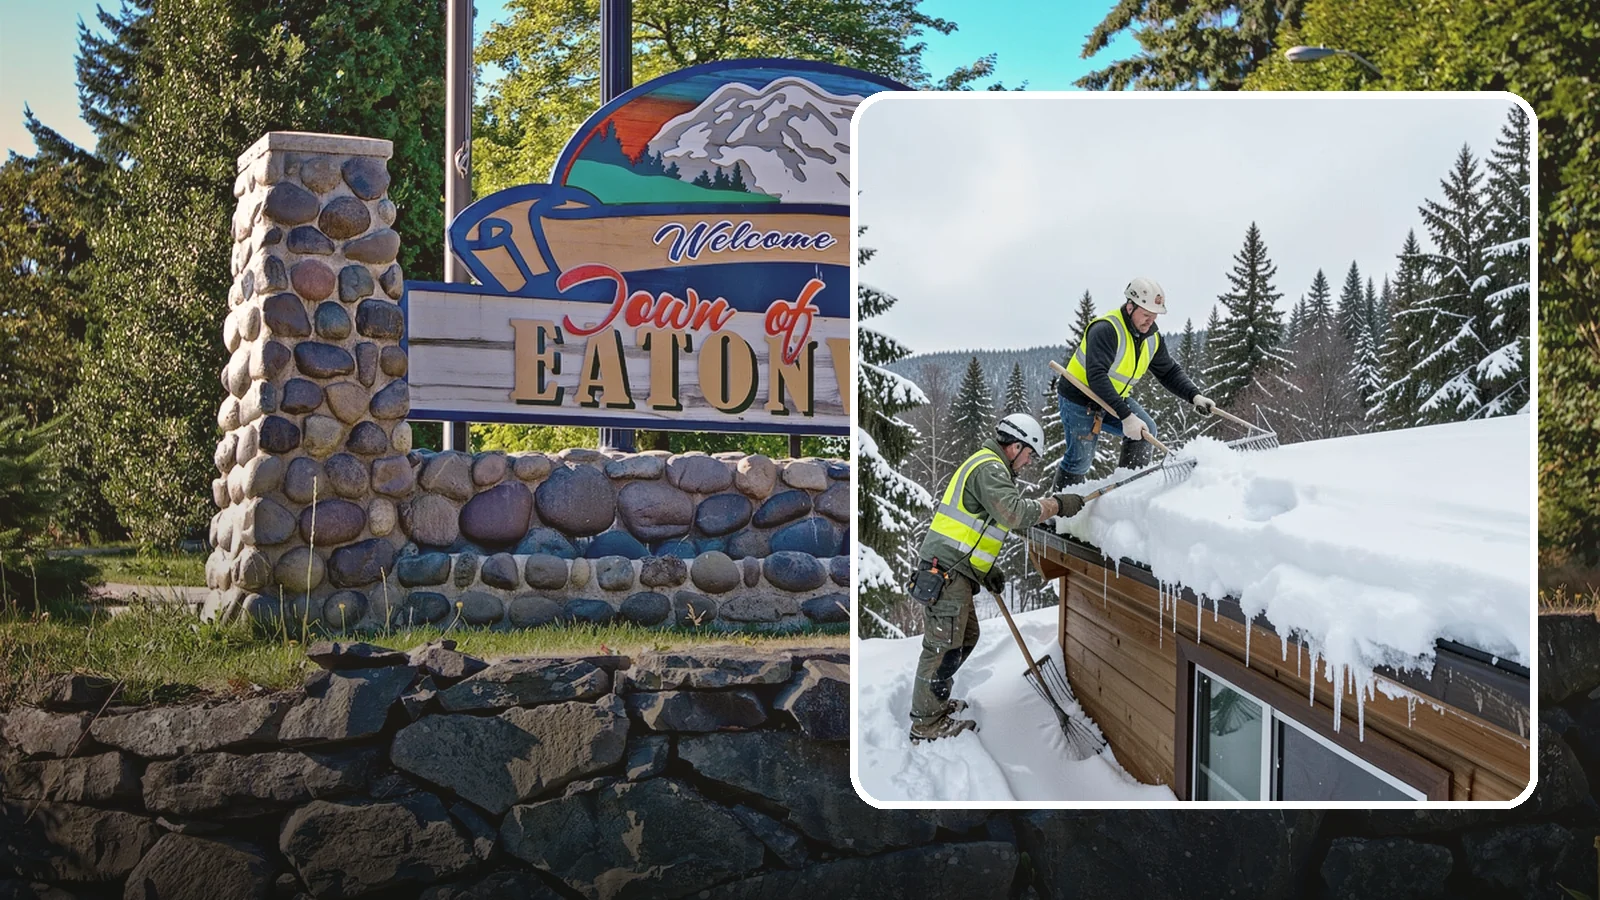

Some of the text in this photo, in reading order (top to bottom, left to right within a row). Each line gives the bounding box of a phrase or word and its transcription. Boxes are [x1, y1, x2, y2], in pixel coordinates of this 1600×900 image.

[653, 220, 837, 263] Welcome
[556, 263, 826, 366] Town of
